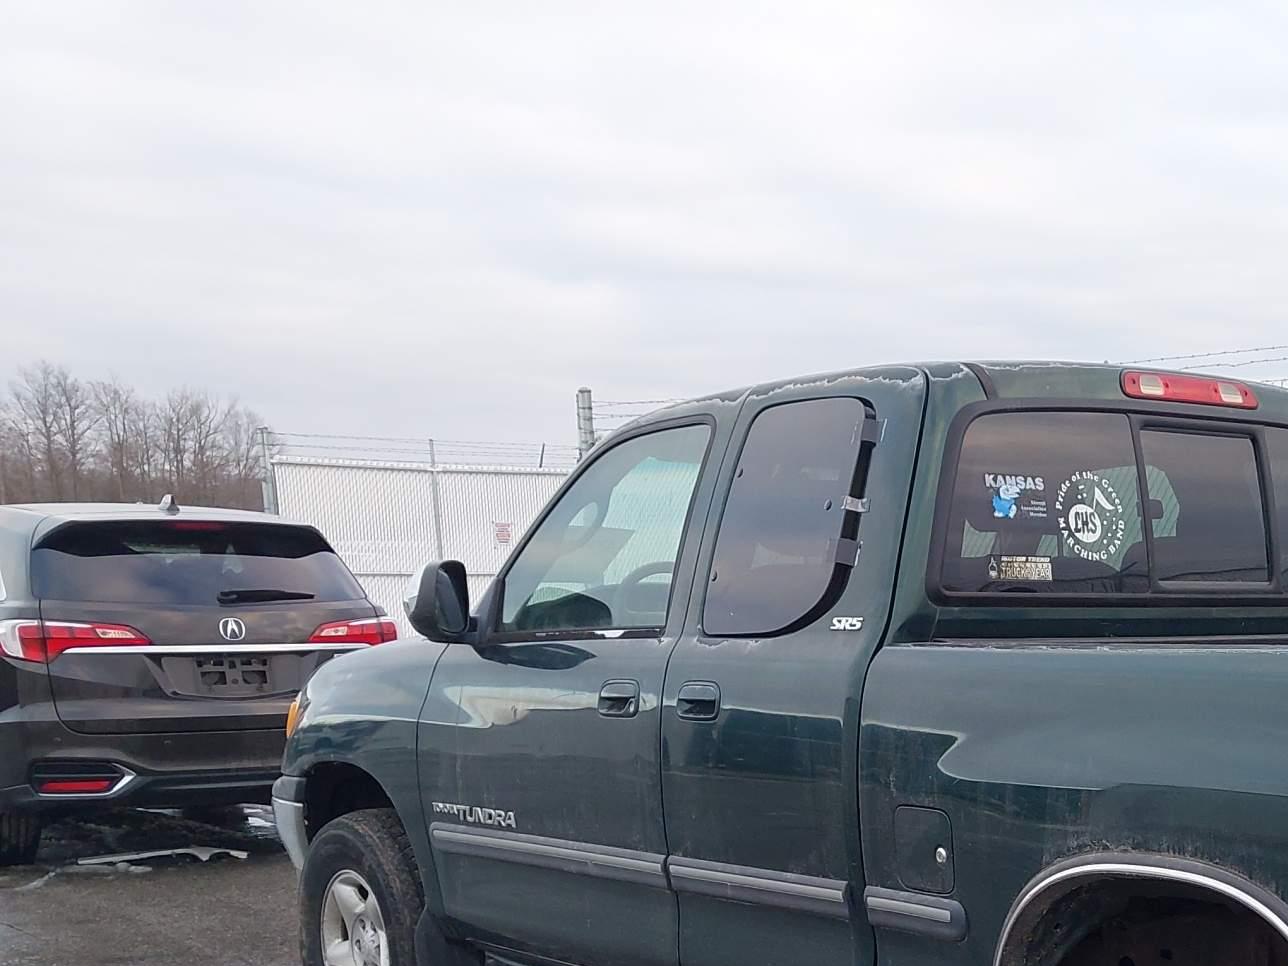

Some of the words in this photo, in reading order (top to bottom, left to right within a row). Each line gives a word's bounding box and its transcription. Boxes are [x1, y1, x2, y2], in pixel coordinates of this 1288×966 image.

[984, 473, 1045, 491] KANSAS
[1056, 480, 1071, 510] Pride
[1072, 471, 1081, 482] of
[1082, 470, 1099, 482] the
[1102, 478, 1123, 513] Green
[1057, 516, 1108, 561] MARCHING
[1108, 519, 1125, 555] BAND
[829, 616, 864, 631] SR5
[456, 804, 517, 828] TUNDRA
